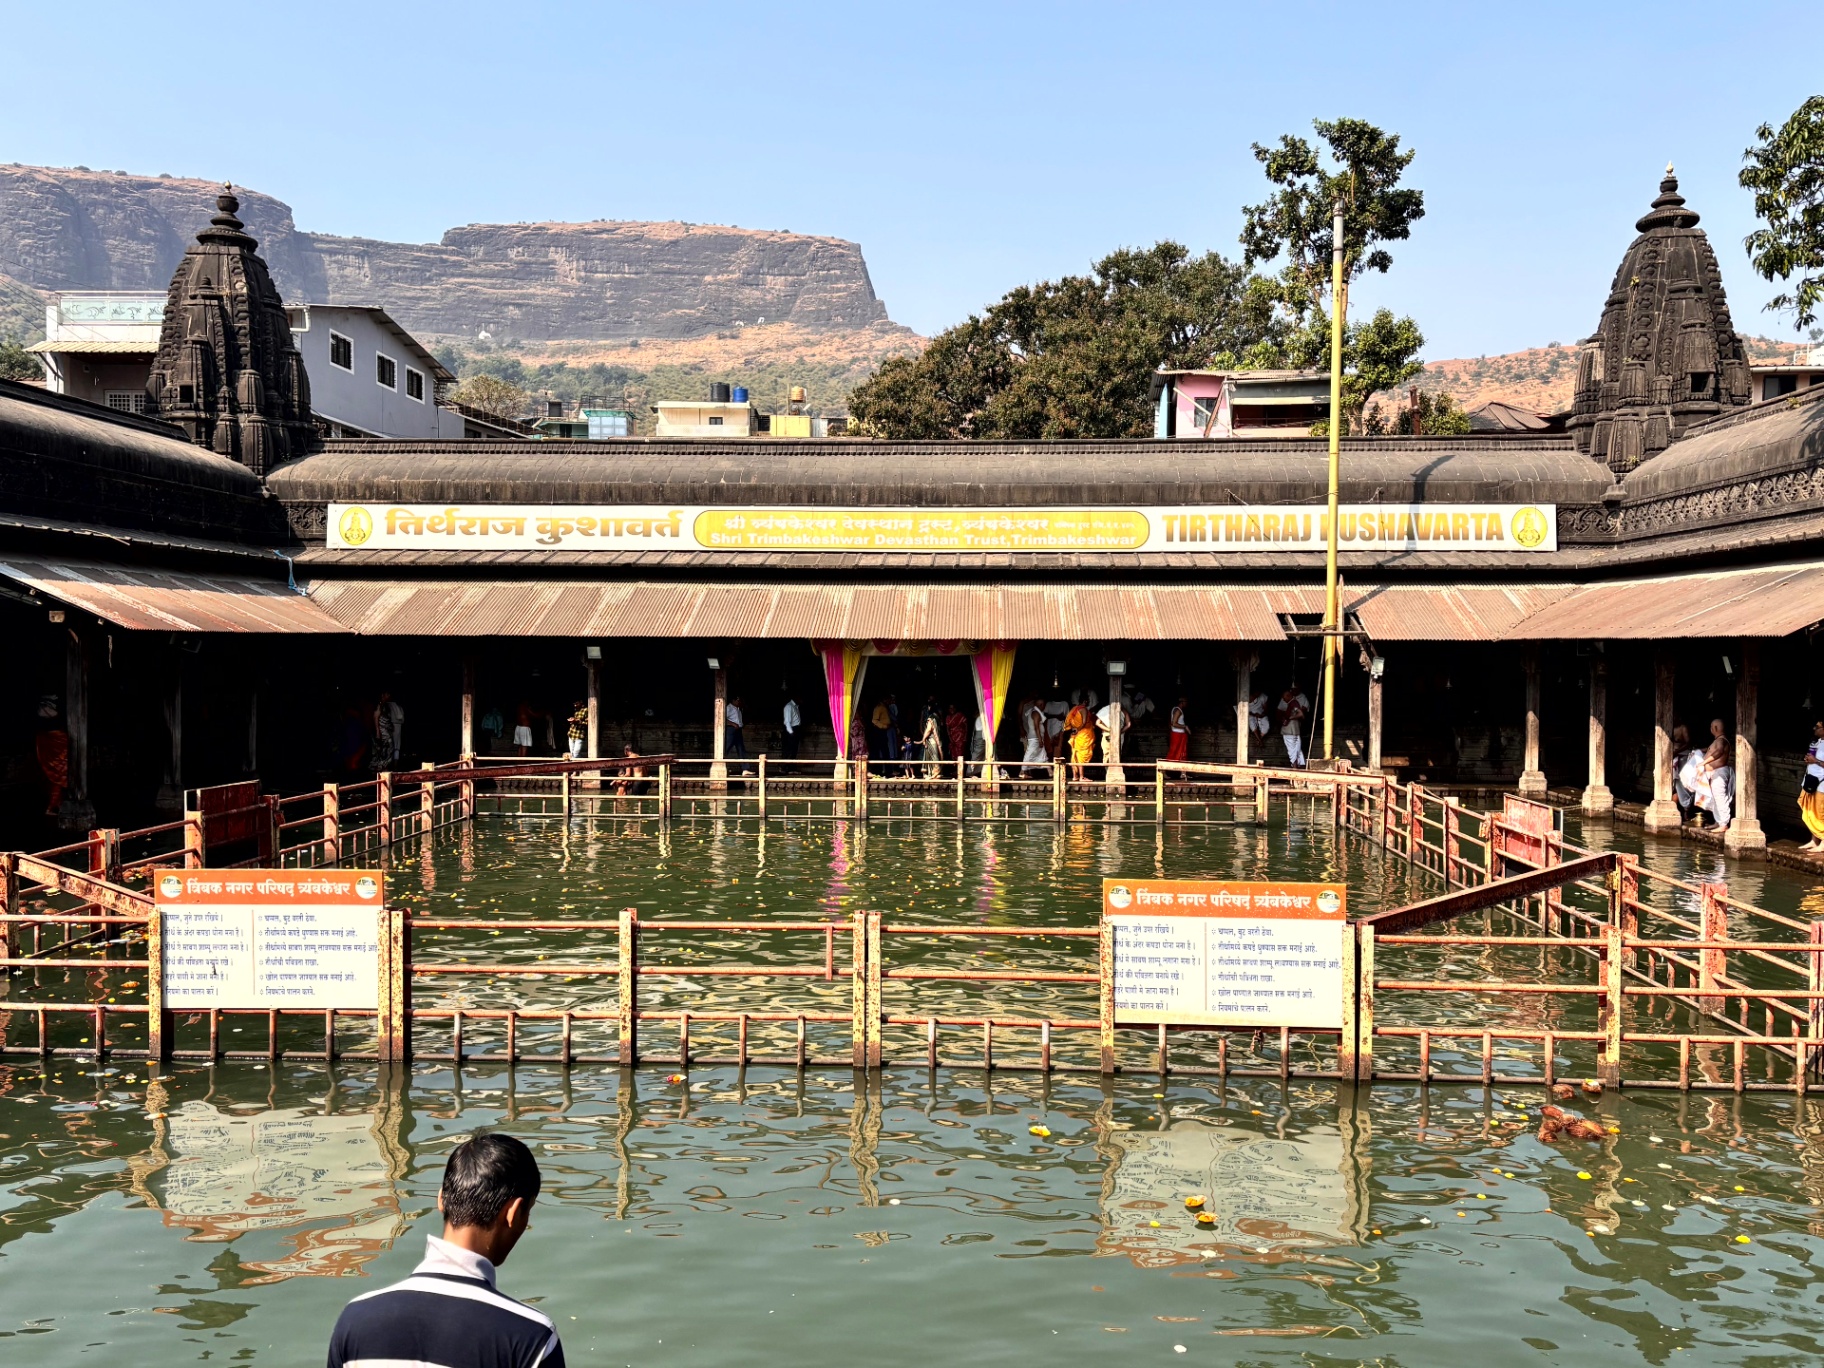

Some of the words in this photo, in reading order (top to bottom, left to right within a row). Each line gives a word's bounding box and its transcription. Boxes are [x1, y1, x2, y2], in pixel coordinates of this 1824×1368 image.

[385, 508, 527, 536] तिर्थराज
[536, 510, 684, 545] कुशावर्त
[724, 514, 746, 530] श्री
[842, 516, 913, 531] देवस्थान
[1162, 513, 1311, 543] TIRTHARAJ
[710, 532, 742, 545] Shri
[747, 532, 870, 546] Trimbakeshwar
[875, 533, 959, 547] Devasthan
[225, 881, 254, 895] नगर
[1177, 892, 1207, 907] नगर
